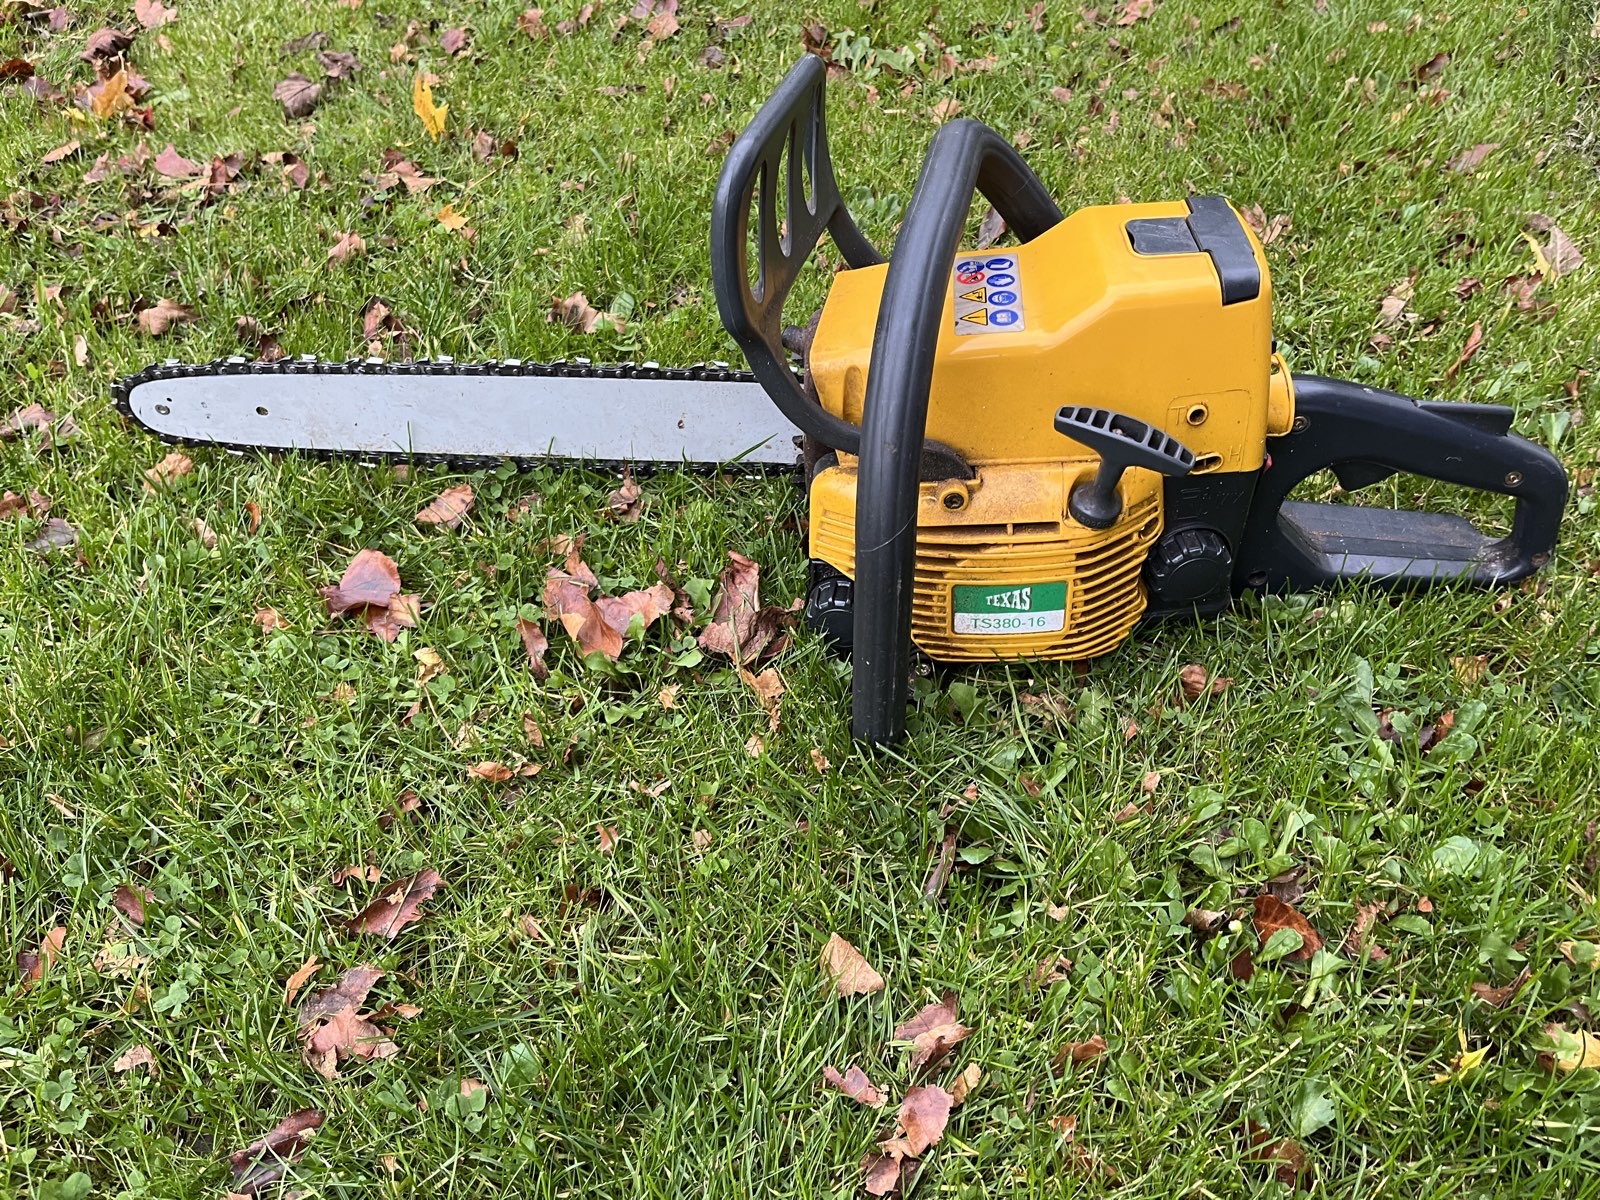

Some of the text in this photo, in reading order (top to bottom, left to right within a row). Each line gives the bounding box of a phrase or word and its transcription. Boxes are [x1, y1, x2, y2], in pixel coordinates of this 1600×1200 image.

[1228, 443, 1242, 462] H
[985, 586, 1031, 611] TEXAS
[970, 616, 1047, 629] TS380-16
